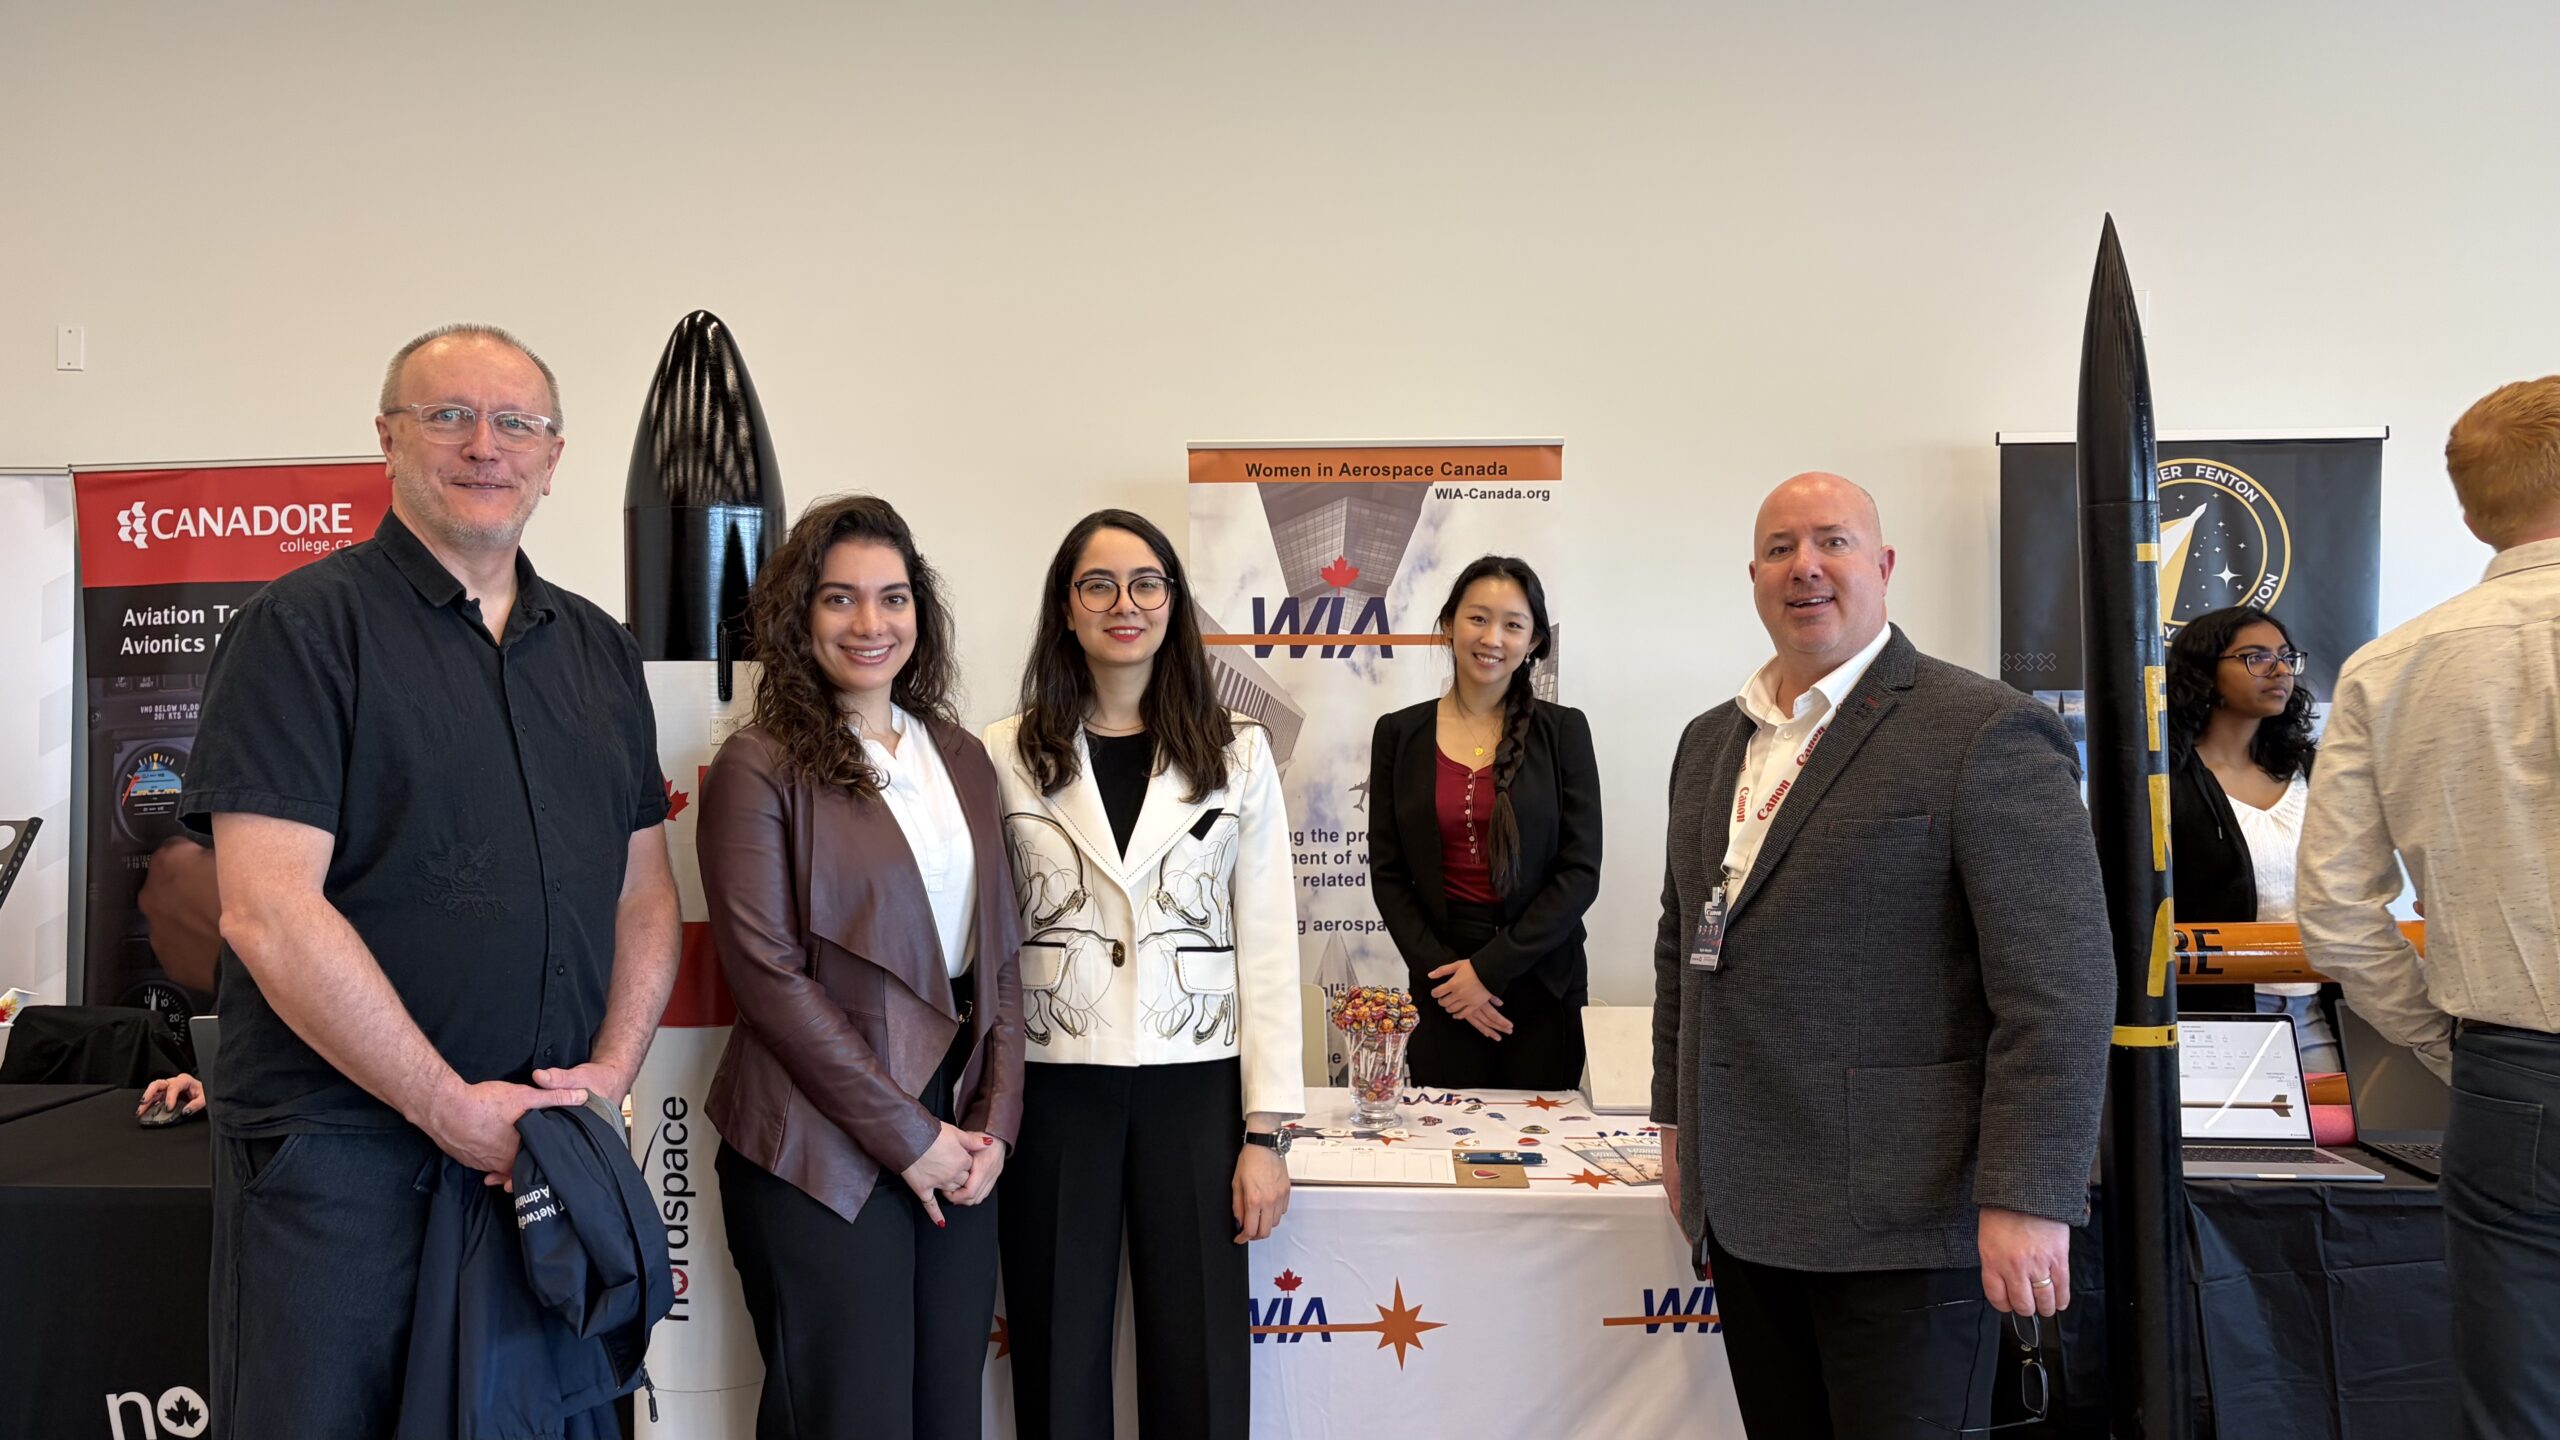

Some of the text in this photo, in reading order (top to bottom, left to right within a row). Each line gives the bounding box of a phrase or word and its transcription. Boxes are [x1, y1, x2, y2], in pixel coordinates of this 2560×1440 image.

[1245, 461, 1508, 480] Women in Aerospace Canada
[2195, 465, 2260, 503] FENTON
[1435, 488, 1551, 502] WIA-Canada.org
[151, 503, 353, 540] CANADORE
[122, 606, 205, 627] Aviation
[1252, 597, 1393, 658] WIA
[120, 635, 205, 655] Avionics
[1796, 726, 1826, 767] Canon
[1736, 786, 1750, 823] Canon
[1757, 779, 1791, 821] Canon
[1311, 828, 1339, 842] the
[1334, 850, 1352, 864] of
[1303, 872, 1366, 887] related
[1643, 1286, 1722, 1334] WI
